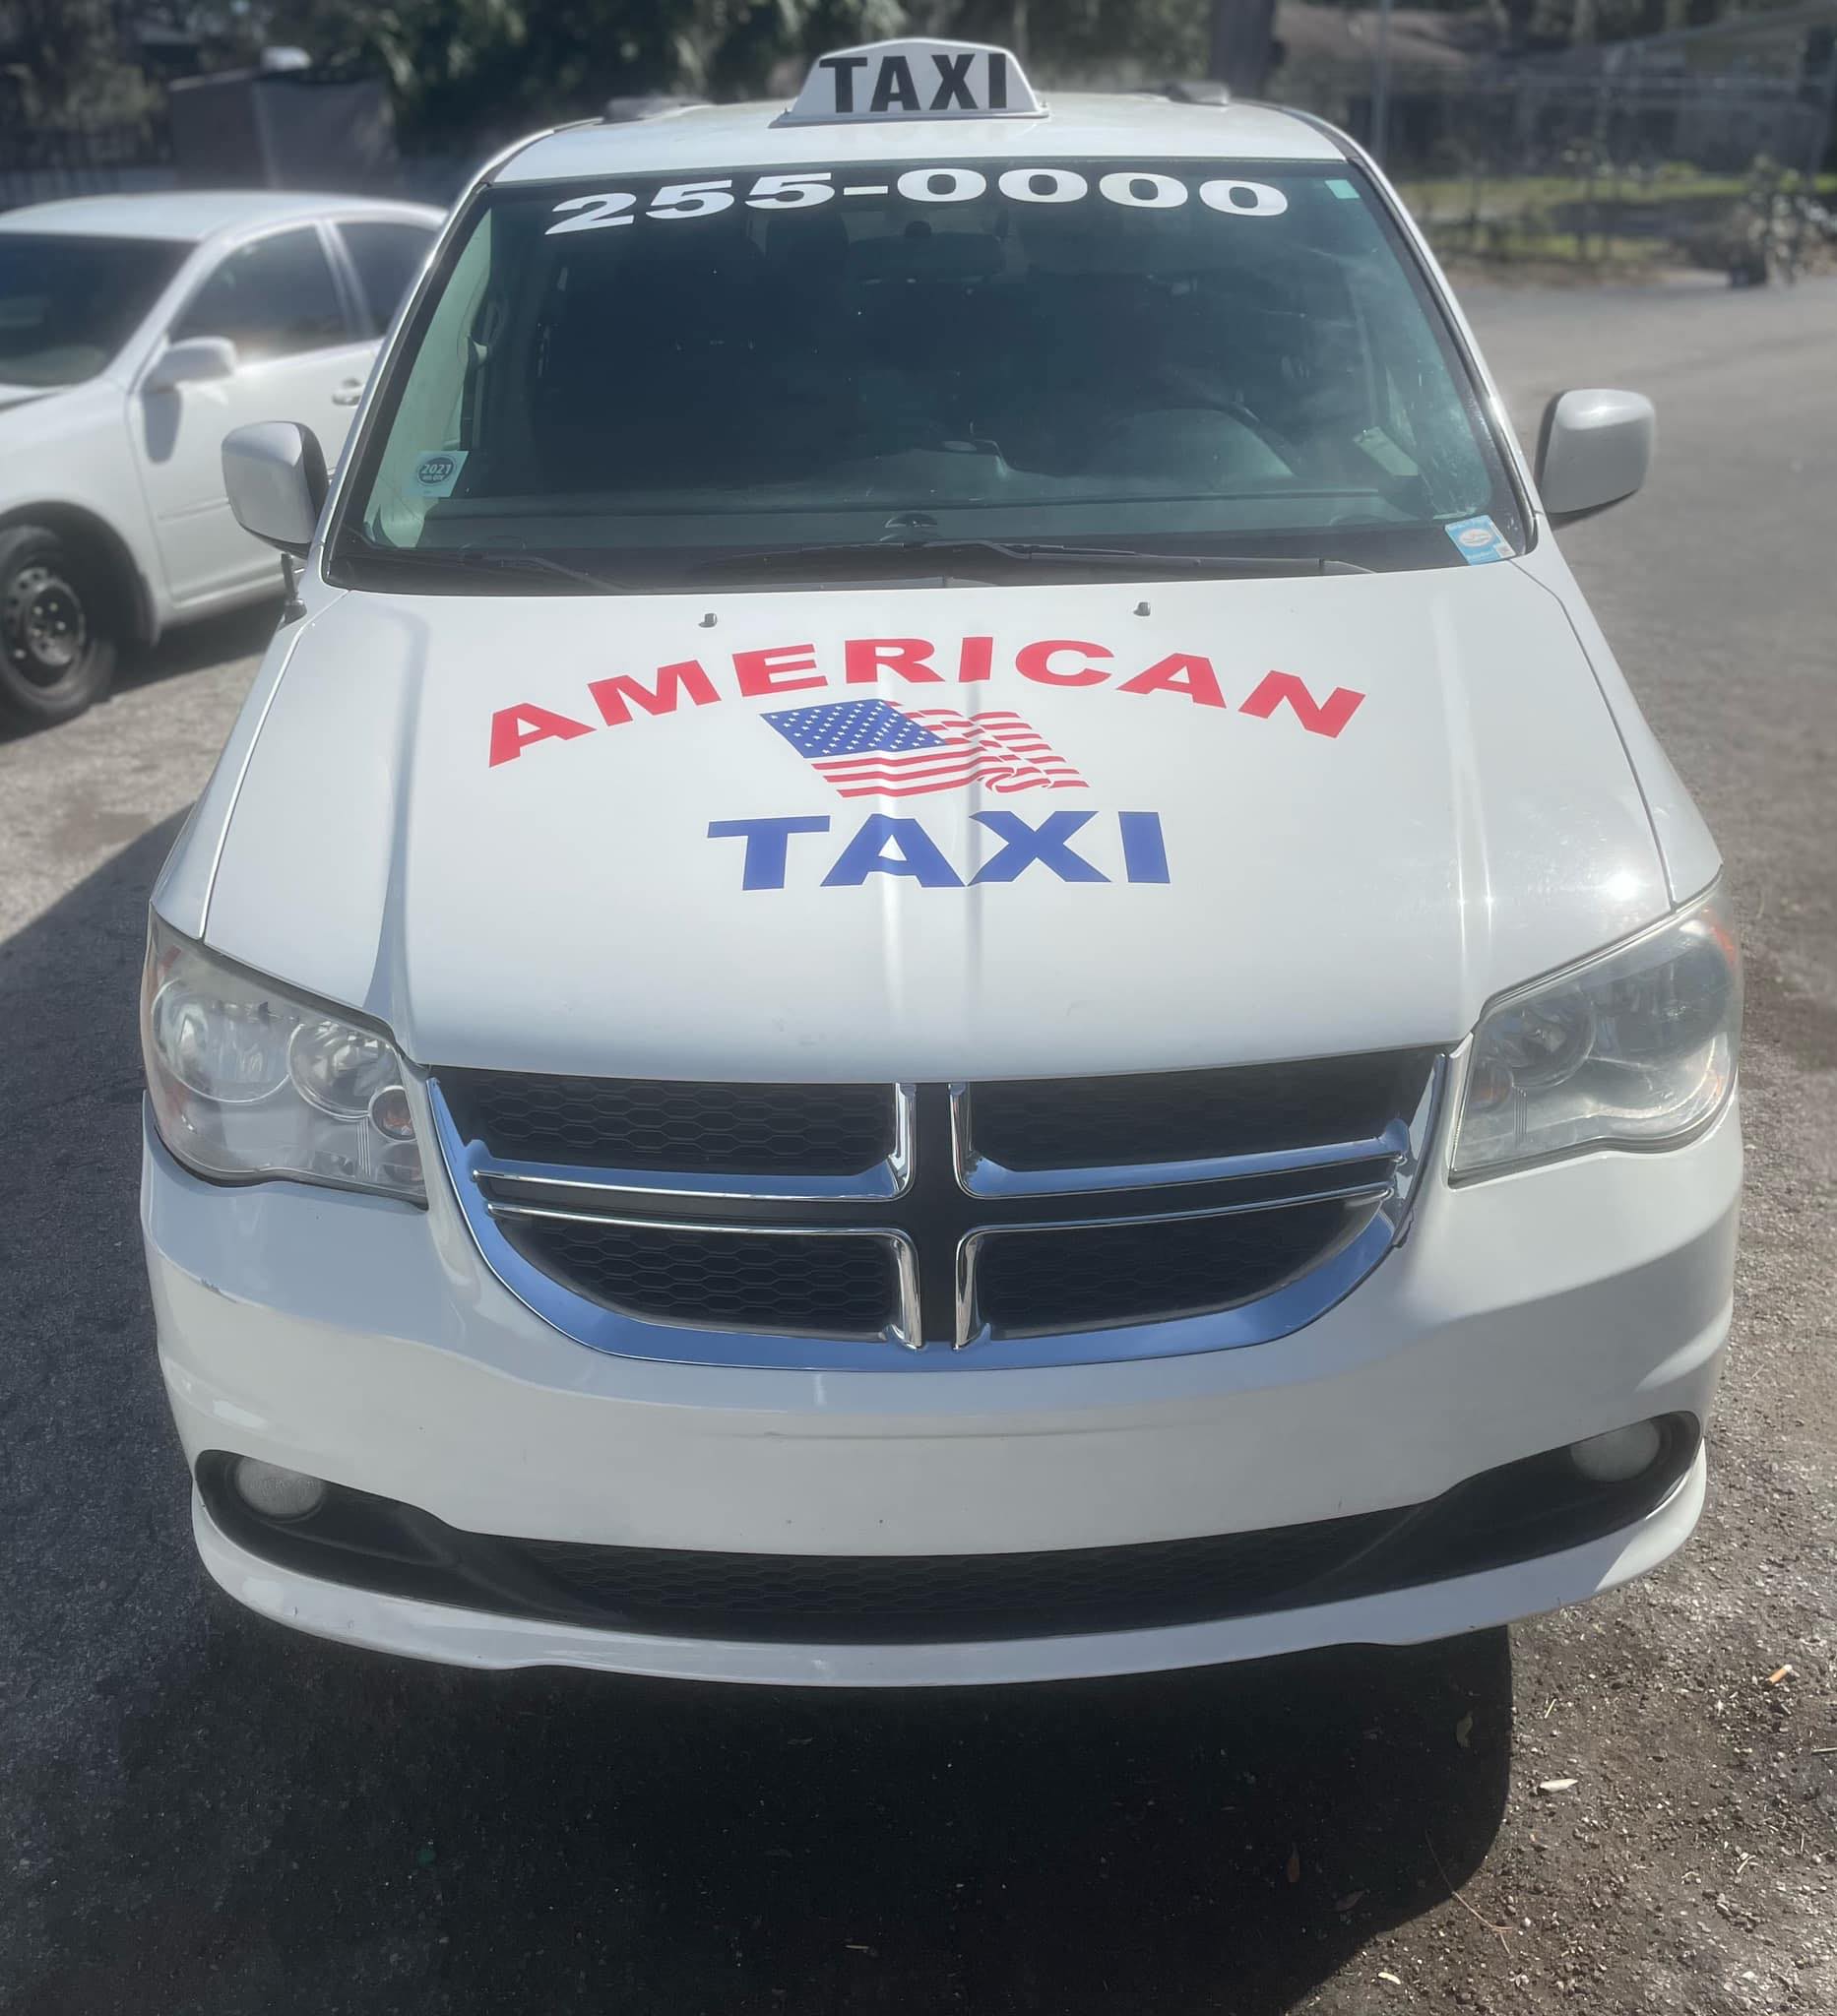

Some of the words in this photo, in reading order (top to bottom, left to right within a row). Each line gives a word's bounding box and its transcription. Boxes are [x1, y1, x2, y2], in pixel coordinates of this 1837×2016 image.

[818, 53, 1007, 114] TAXI
[544, 167, 1289, 235] 255-0000
[488, 636, 1364, 767] AMERICAN
[707, 811, 1171, 890] TAXI
